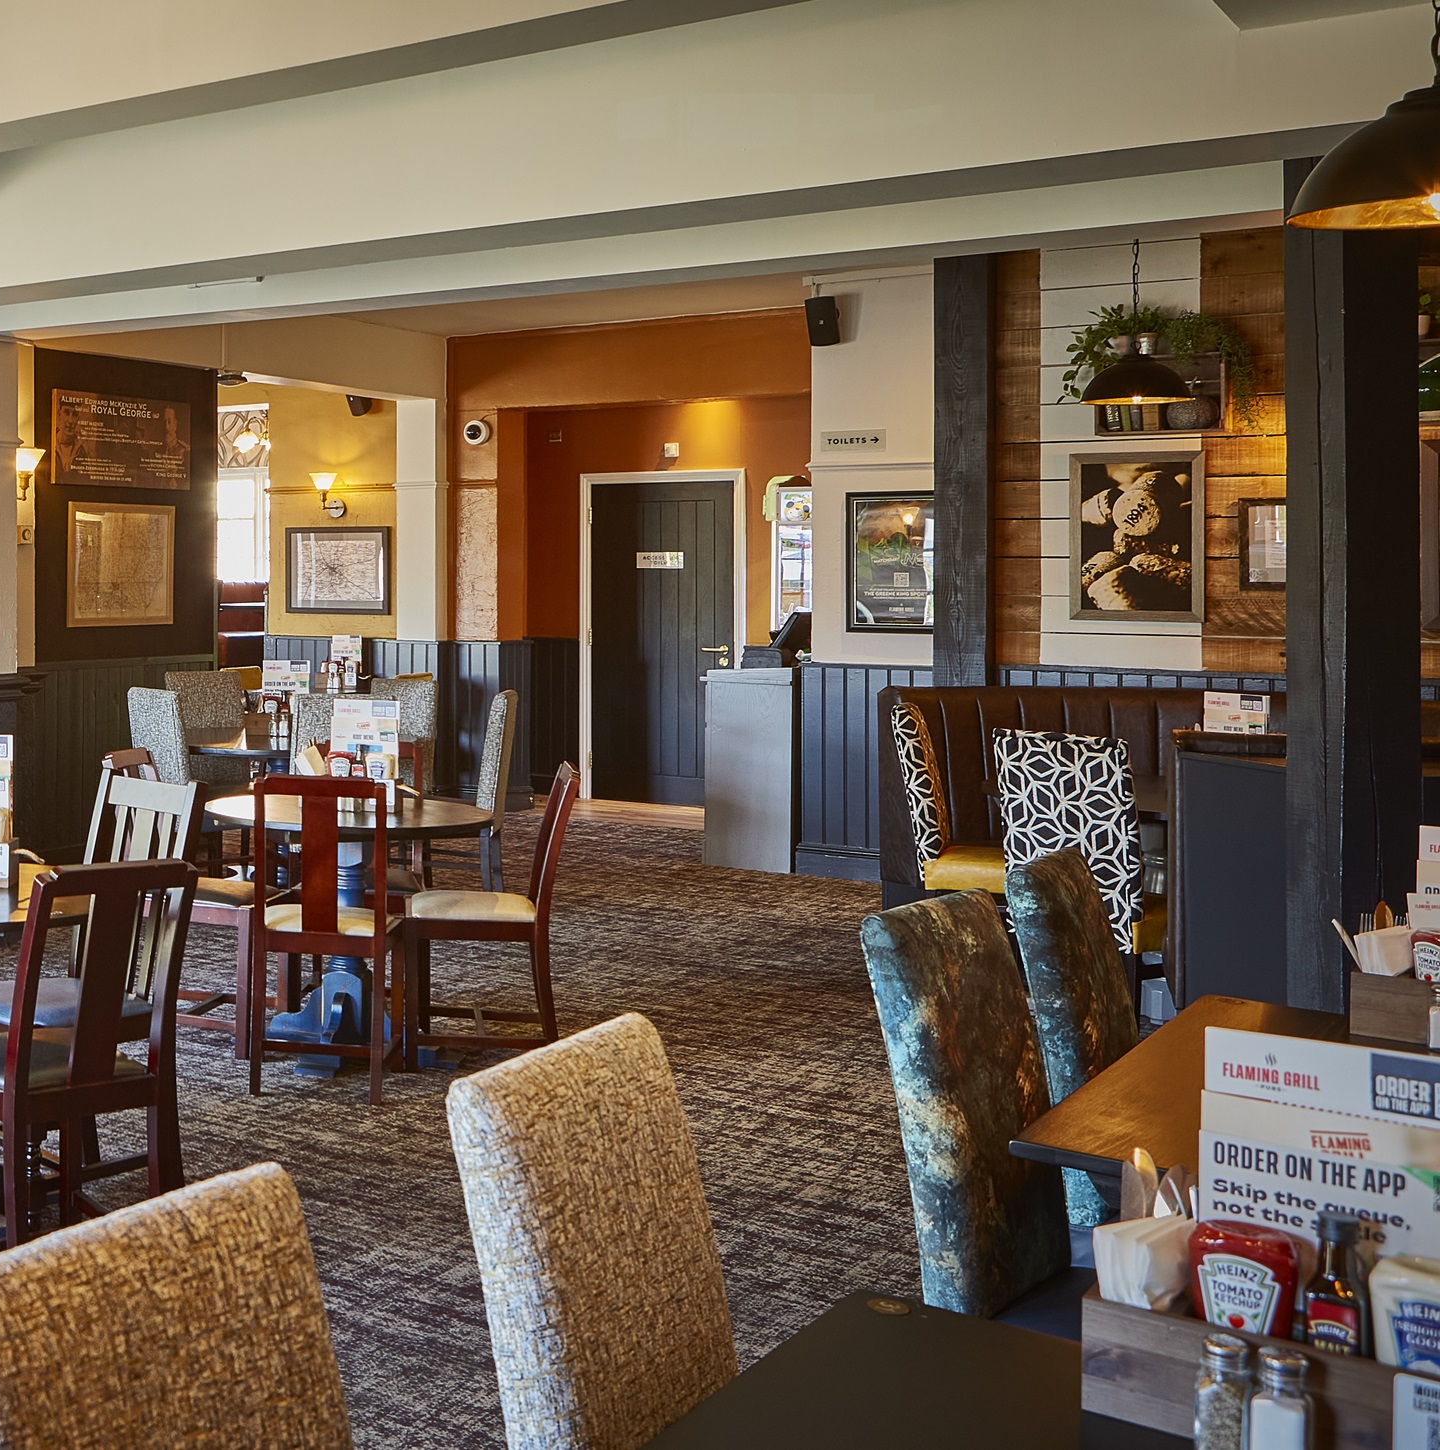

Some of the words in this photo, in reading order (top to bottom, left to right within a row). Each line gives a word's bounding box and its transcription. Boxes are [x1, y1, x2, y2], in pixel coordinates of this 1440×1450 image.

[90, 405, 117, 416] ROYAL
[120, 408, 151, 419] GEORGE
[827, 437, 867, 445] TOILETS
[1420, 947, 1439, 957] HEINZ
[1222, 1062, 1279, 1085] FLAMING
[1283, 1071, 1320, 1091] GRILL
[1375, 1075, 1431, 1102] ORDER
[1375, 1096, 1389, 1109] ON
[1391, 1098, 1409, 1112] THE
[1409, 1101, 1430, 1115] APP
[1311, 1135, 1372, 1151] FLAMING
[1213, 1141, 1278, 1176] ORDER
[1285, 1154, 1312, 1182] ON
[1318, 1159, 1357, 1190] THE
[1362, 1168, 1407, 1198] APP
[1213, 1178, 1268, 1204] Skip
[1274, 1190, 1317, 1211] the
[1213, 1200, 1255, 1219] not
[1262, 1207, 1304, 1228] the
[1216, 1264, 1258, 1282] HEINZ
[1211, 1280, 1263, 1301] TOMATO
[1214, 1291, 1262, 1309] KETCHUP
[1402, 1304, 1440, 1322] HEIN
[1316, 1324, 1347, 1340] HEINZ
